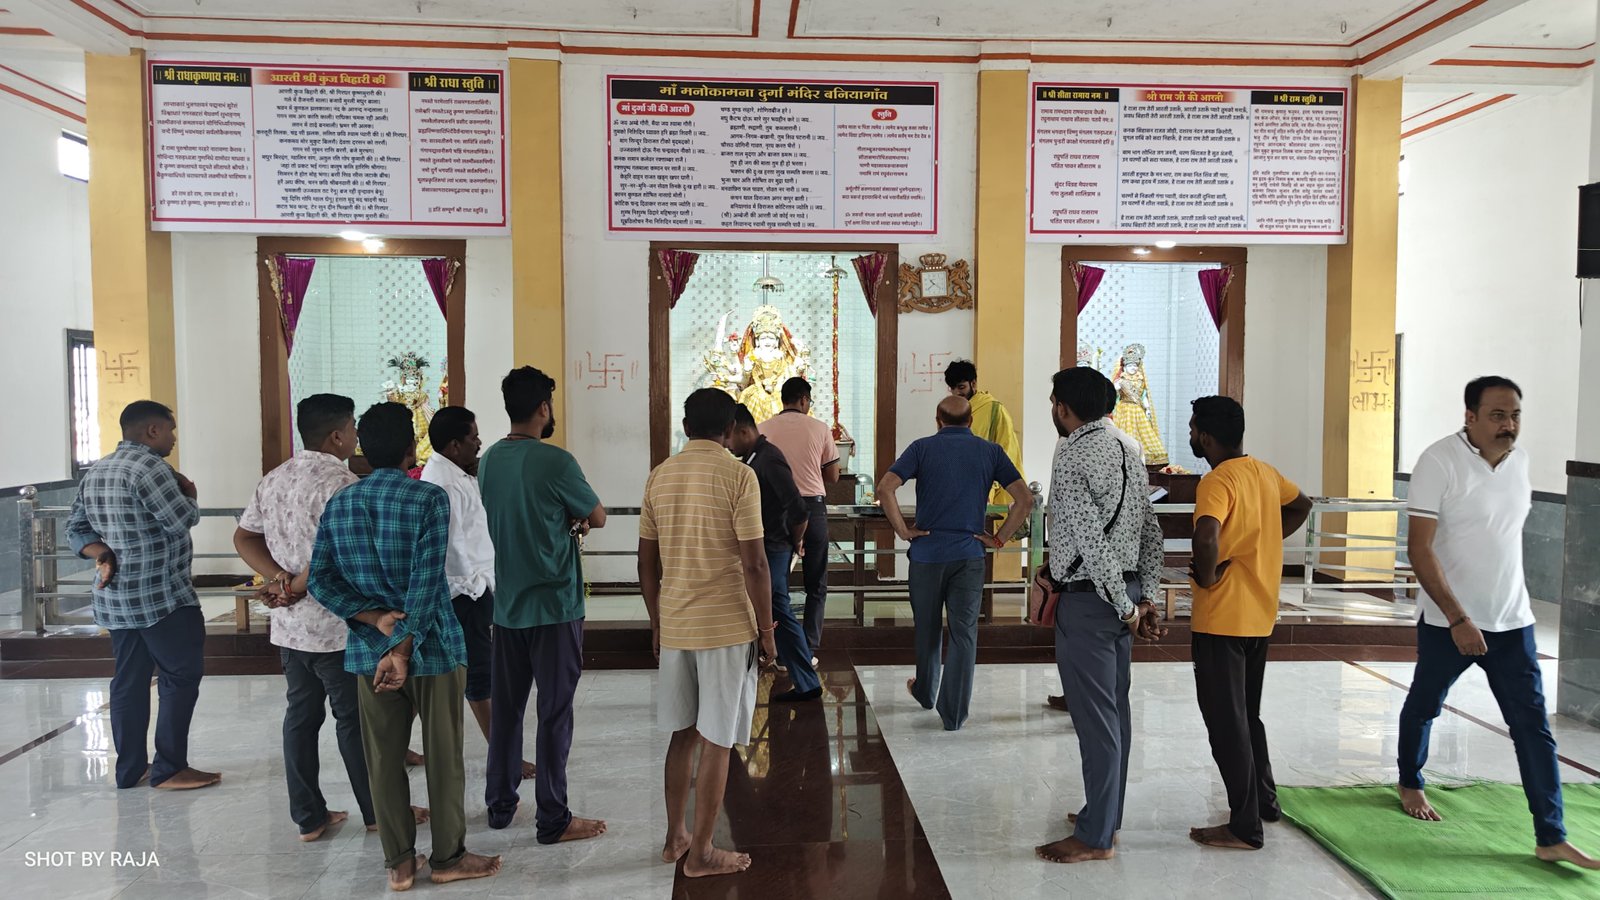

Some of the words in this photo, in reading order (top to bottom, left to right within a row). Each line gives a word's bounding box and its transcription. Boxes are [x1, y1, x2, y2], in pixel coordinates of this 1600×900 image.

[164, 70, 175, 80] श्री
[176, 70, 221, 84] राधाकृष्णाय
[271, 72, 300, 82] आरती
[303, 72, 316, 83] श्री
[319, 72, 337, 85] कुंज
[340, 73, 370, 84] बिहारी
[372, 74, 386, 84] की
[424, 75, 437, 88] श्री
[439, 78, 459, 88] राधा
[462, 76, 484, 92] स्तुति
[660, 83, 676, 96] माँ
[681, 85, 754, 98] मनोकामना
[758, 86, 783, 102] दुर्गा
[787, 86, 820, 100] मंदिर
[824, 87, 888, 100] बनियागाँव
[1048, 90, 1056, 98] श्री
[1057, 90, 1072, 98] सीता
[1146, 91, 1157, 101] श्री
[1160, 93, 1172, 101] राम
[1175, 91, 1185, 101] जी
[1188, 92, 1198, 101] की
[1201, 92, 1224, 102] आरती
[1280, 94, 1288, 103] श्री
[1301, 94, 1316, 105] स्तुति
[646, 104, 657, 112] जी
[658, 104, 669, 112] की
[670, 105, 690, 113] आरती
[877, 110, 892, 119] स्तुति
